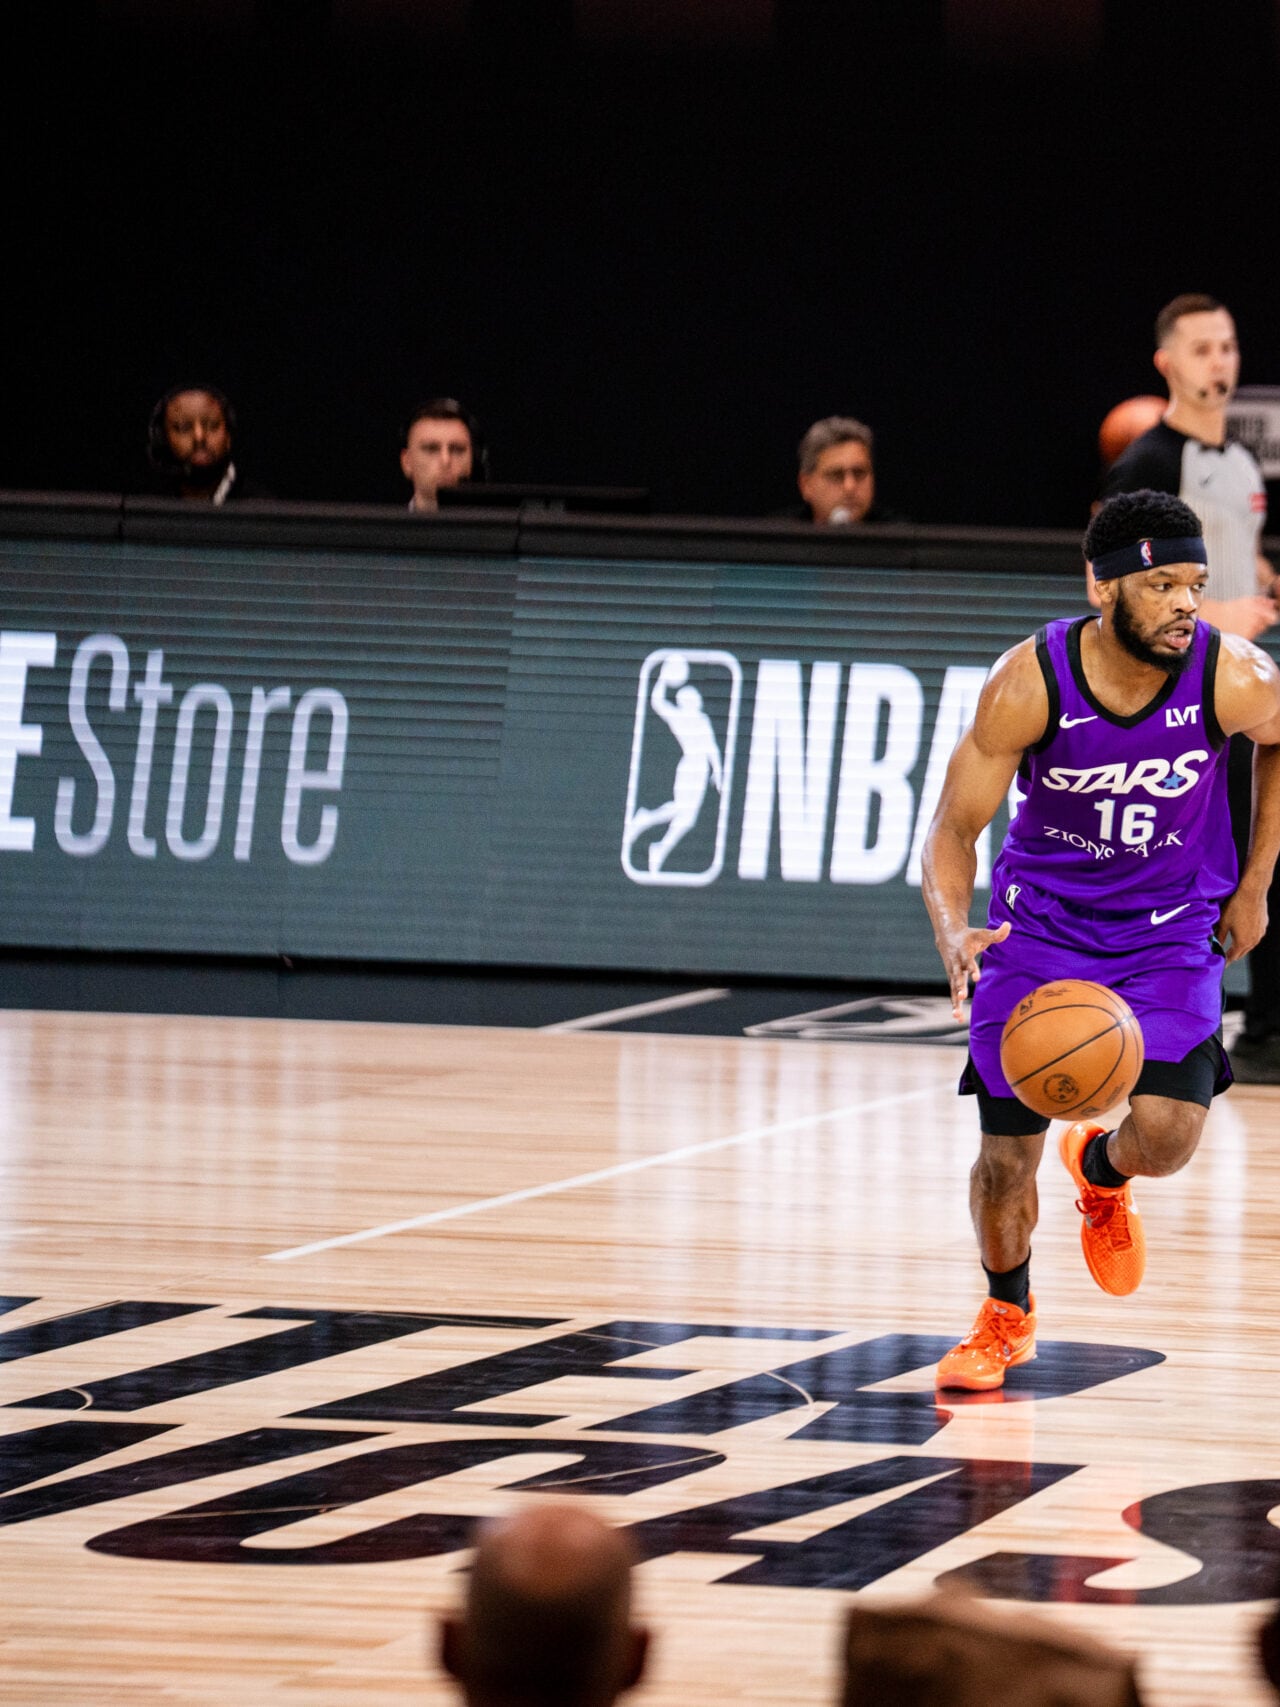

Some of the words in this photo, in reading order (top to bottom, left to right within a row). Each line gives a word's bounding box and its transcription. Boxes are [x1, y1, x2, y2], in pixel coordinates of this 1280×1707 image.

[54, 632, 348, 867] Store
[1041, 749, 1209, 798] STARS
[1093, 798, 1157, 846] 16
